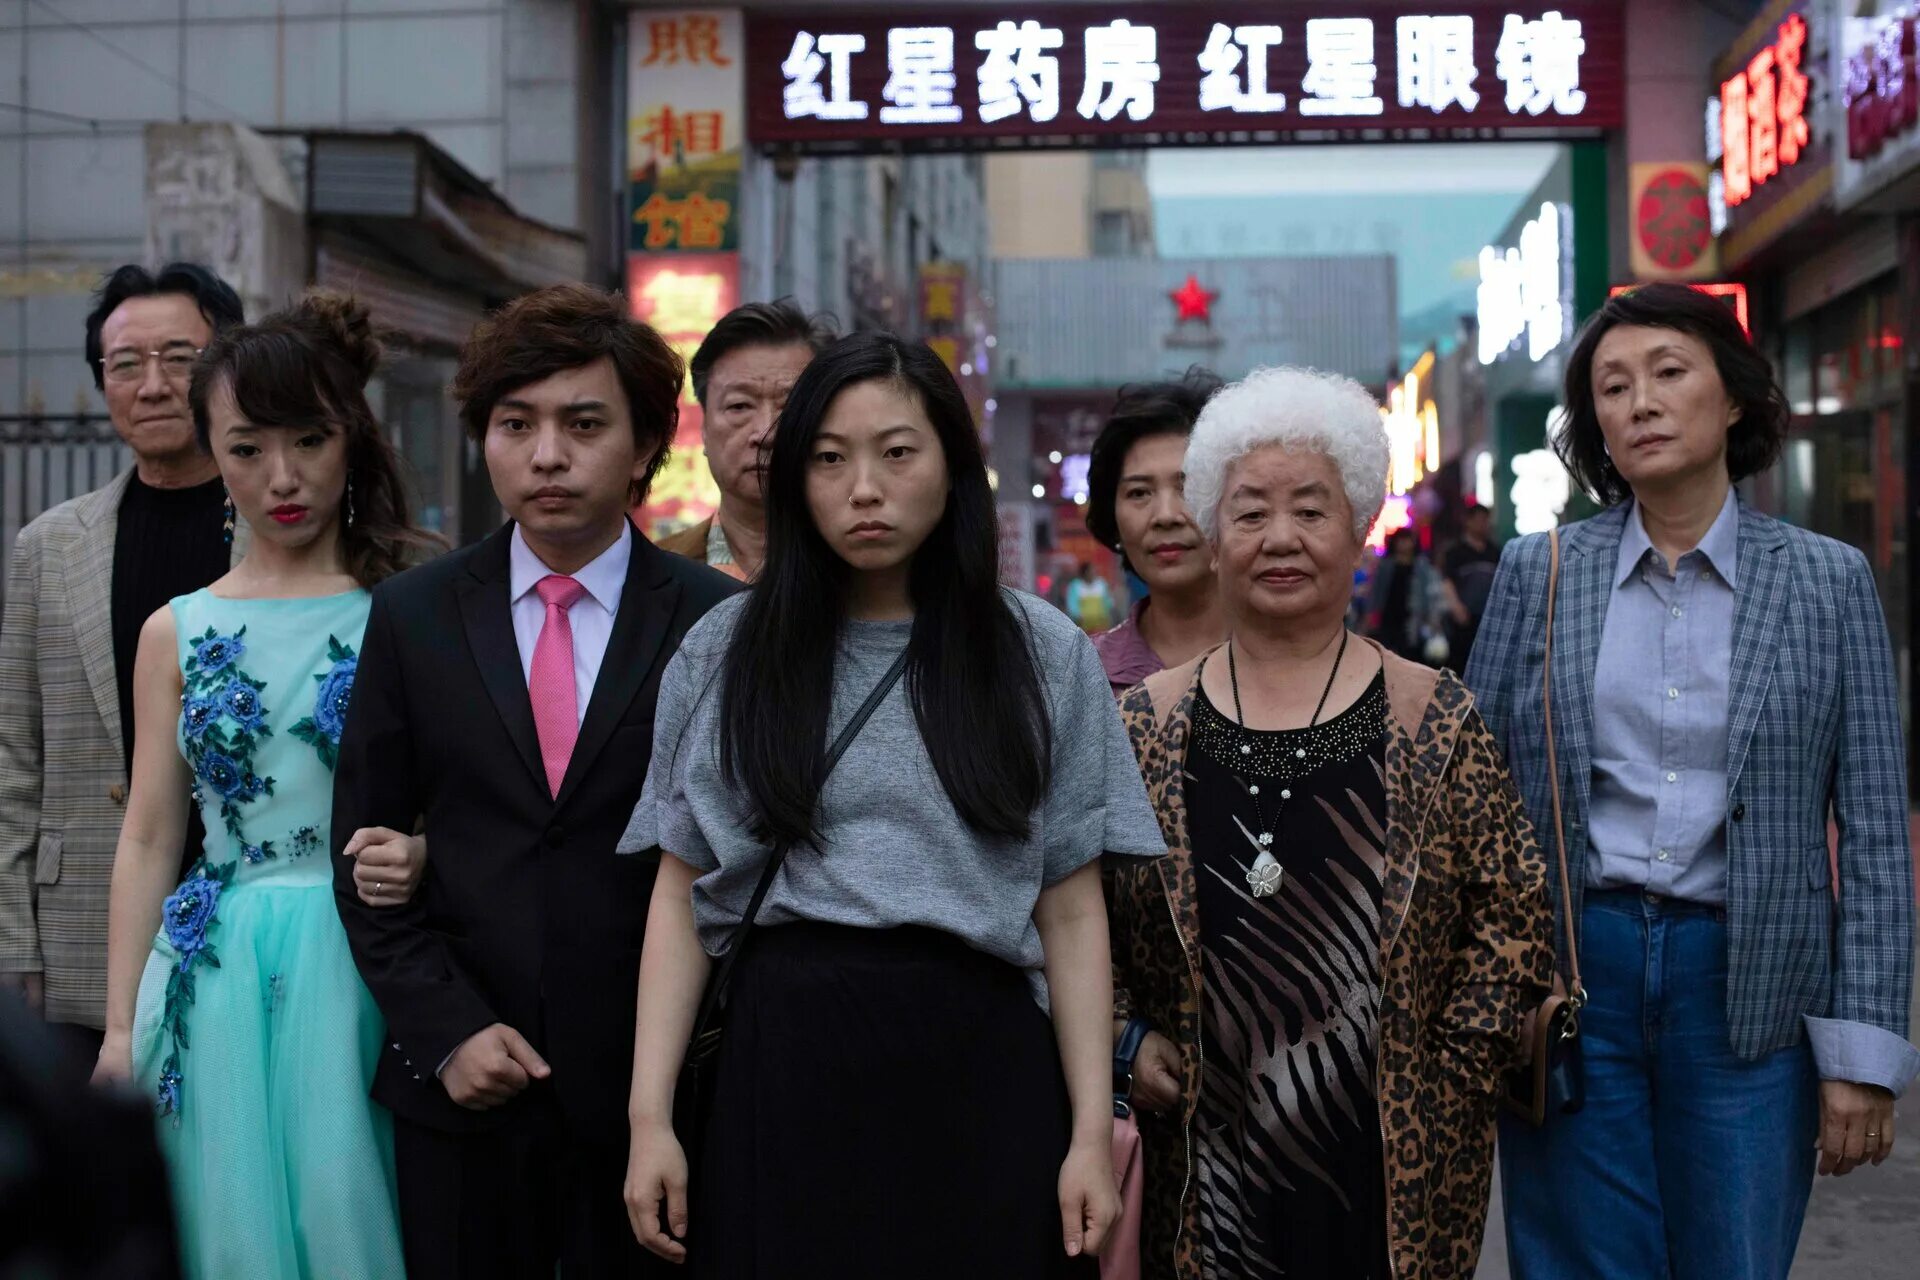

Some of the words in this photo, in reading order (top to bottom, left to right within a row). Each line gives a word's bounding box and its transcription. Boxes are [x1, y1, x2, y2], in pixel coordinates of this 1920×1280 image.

[780, 19, 1162, 124] 红星药房
[1198, 11, 1587, 117] 红星眼镜
